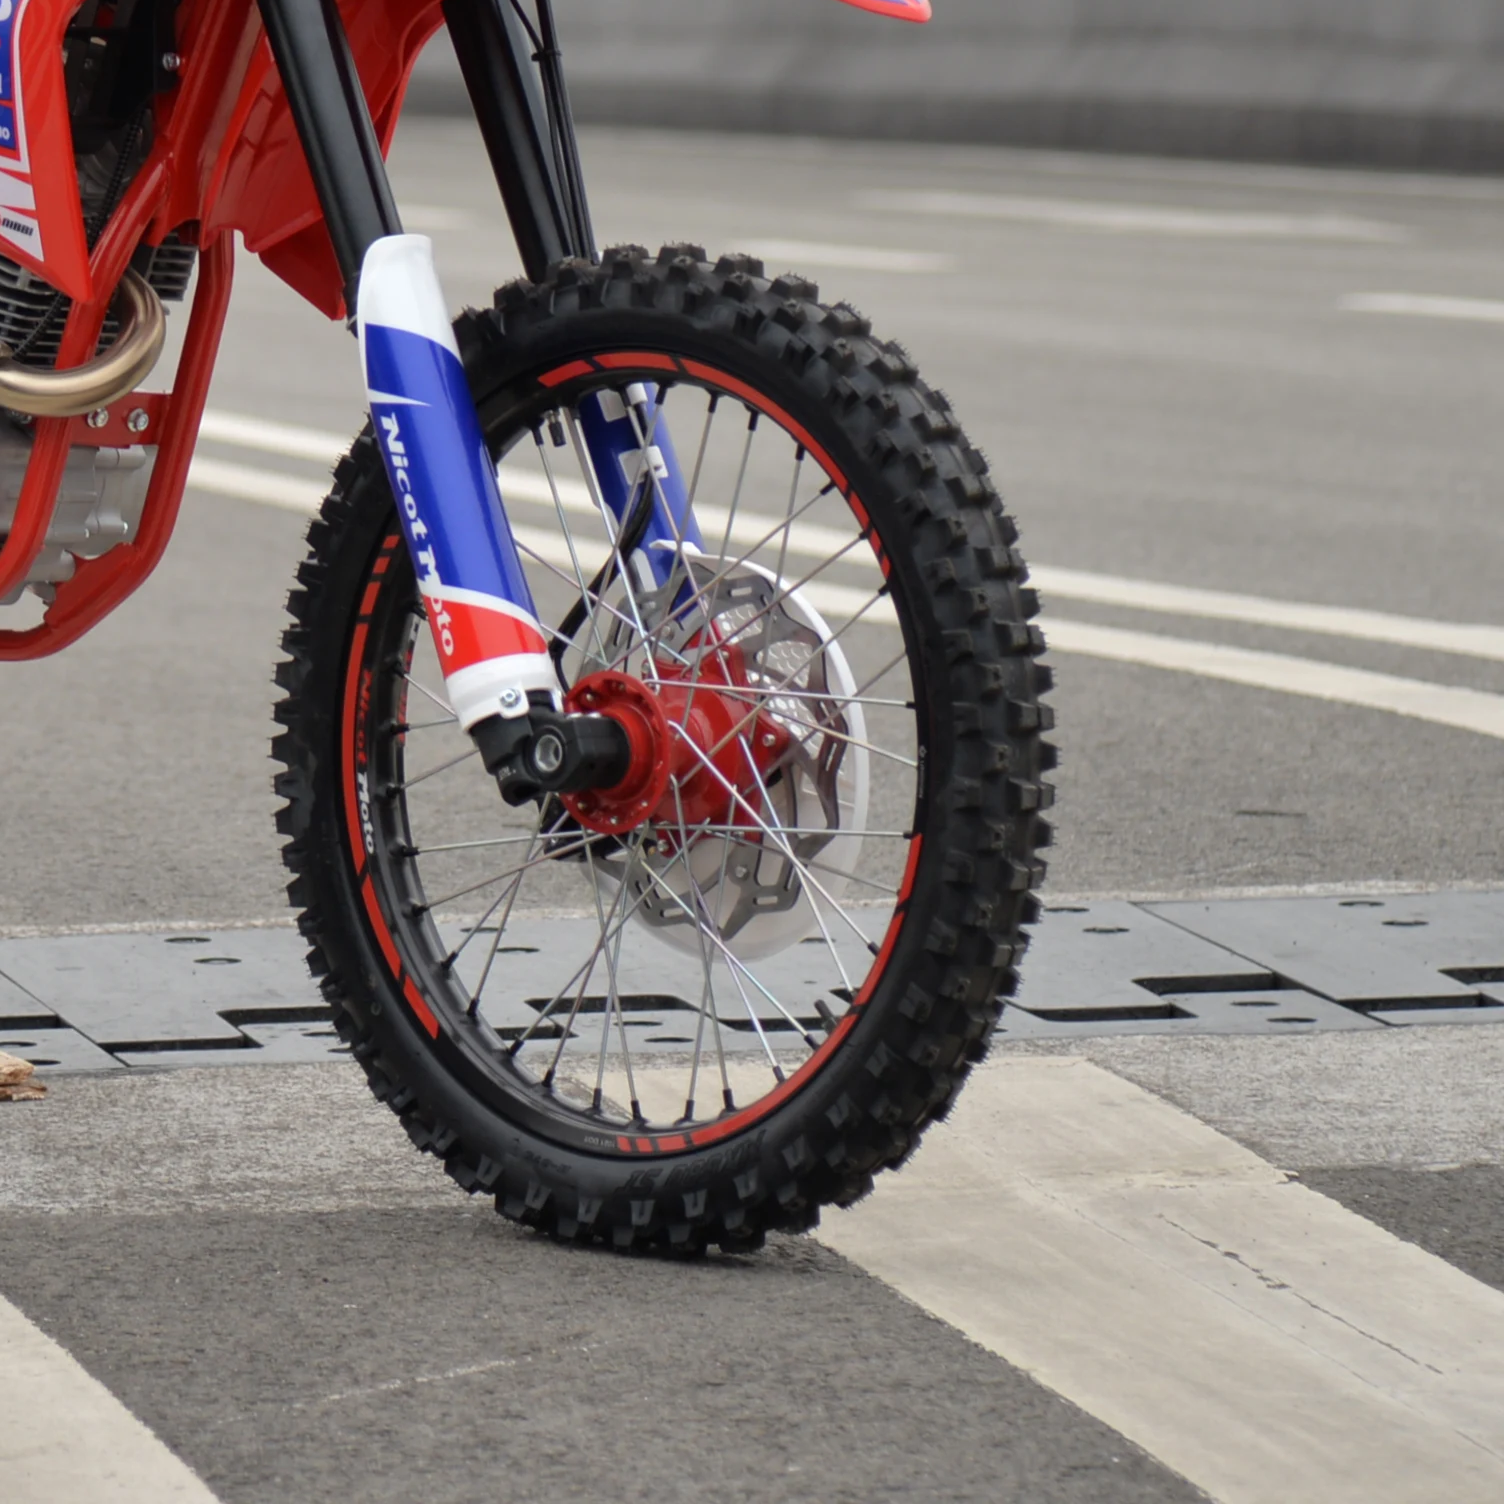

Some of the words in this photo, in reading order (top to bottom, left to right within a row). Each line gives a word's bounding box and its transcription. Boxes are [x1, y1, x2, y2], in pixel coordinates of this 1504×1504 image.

[380, 412, 428, 541] Nicot
[417, 544, 454, 656] Moto
[357, 771, 374, 855] Moto
